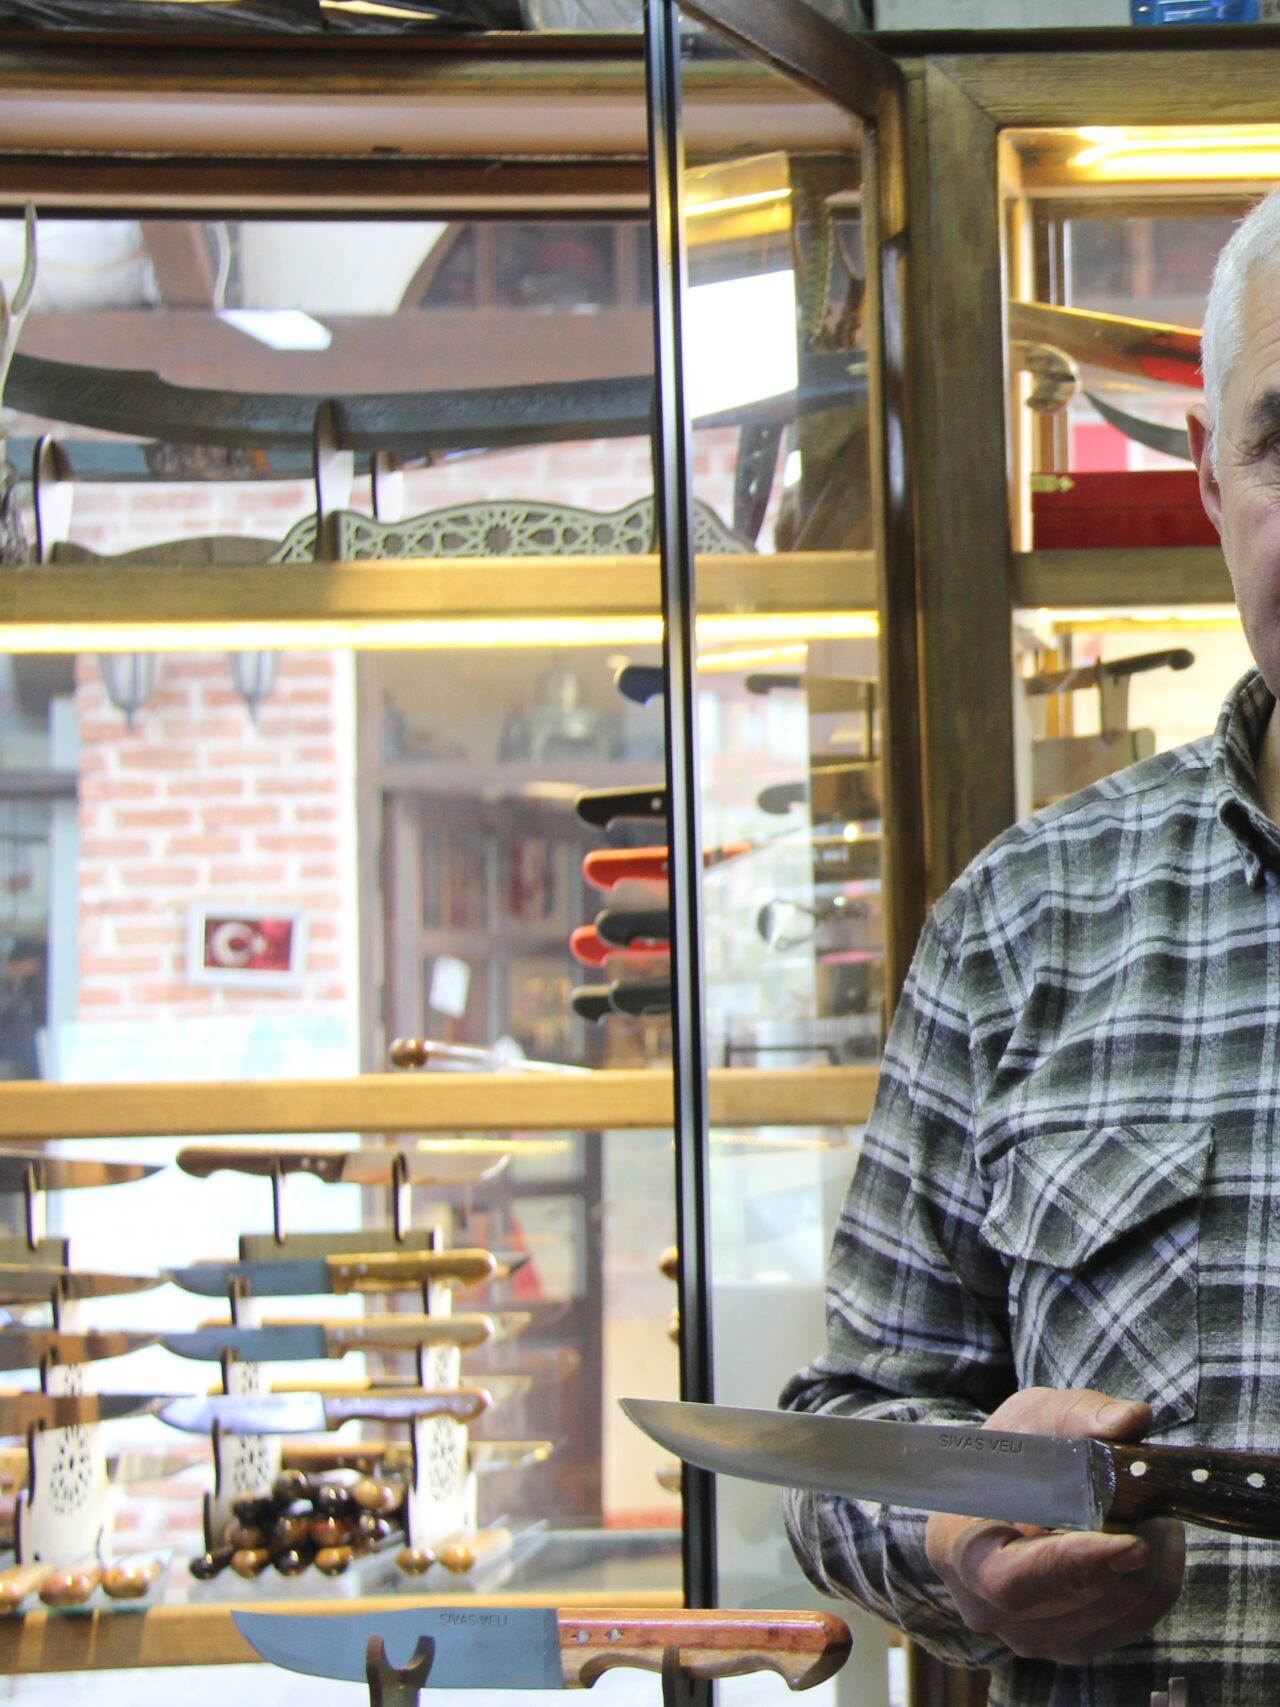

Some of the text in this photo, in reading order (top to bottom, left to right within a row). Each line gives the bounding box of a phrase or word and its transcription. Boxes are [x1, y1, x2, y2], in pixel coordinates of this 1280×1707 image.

[938, 1433, 1023, 1453] SIVAS VELI
[439, 1612, 508, 1626] SIVAS VELI
